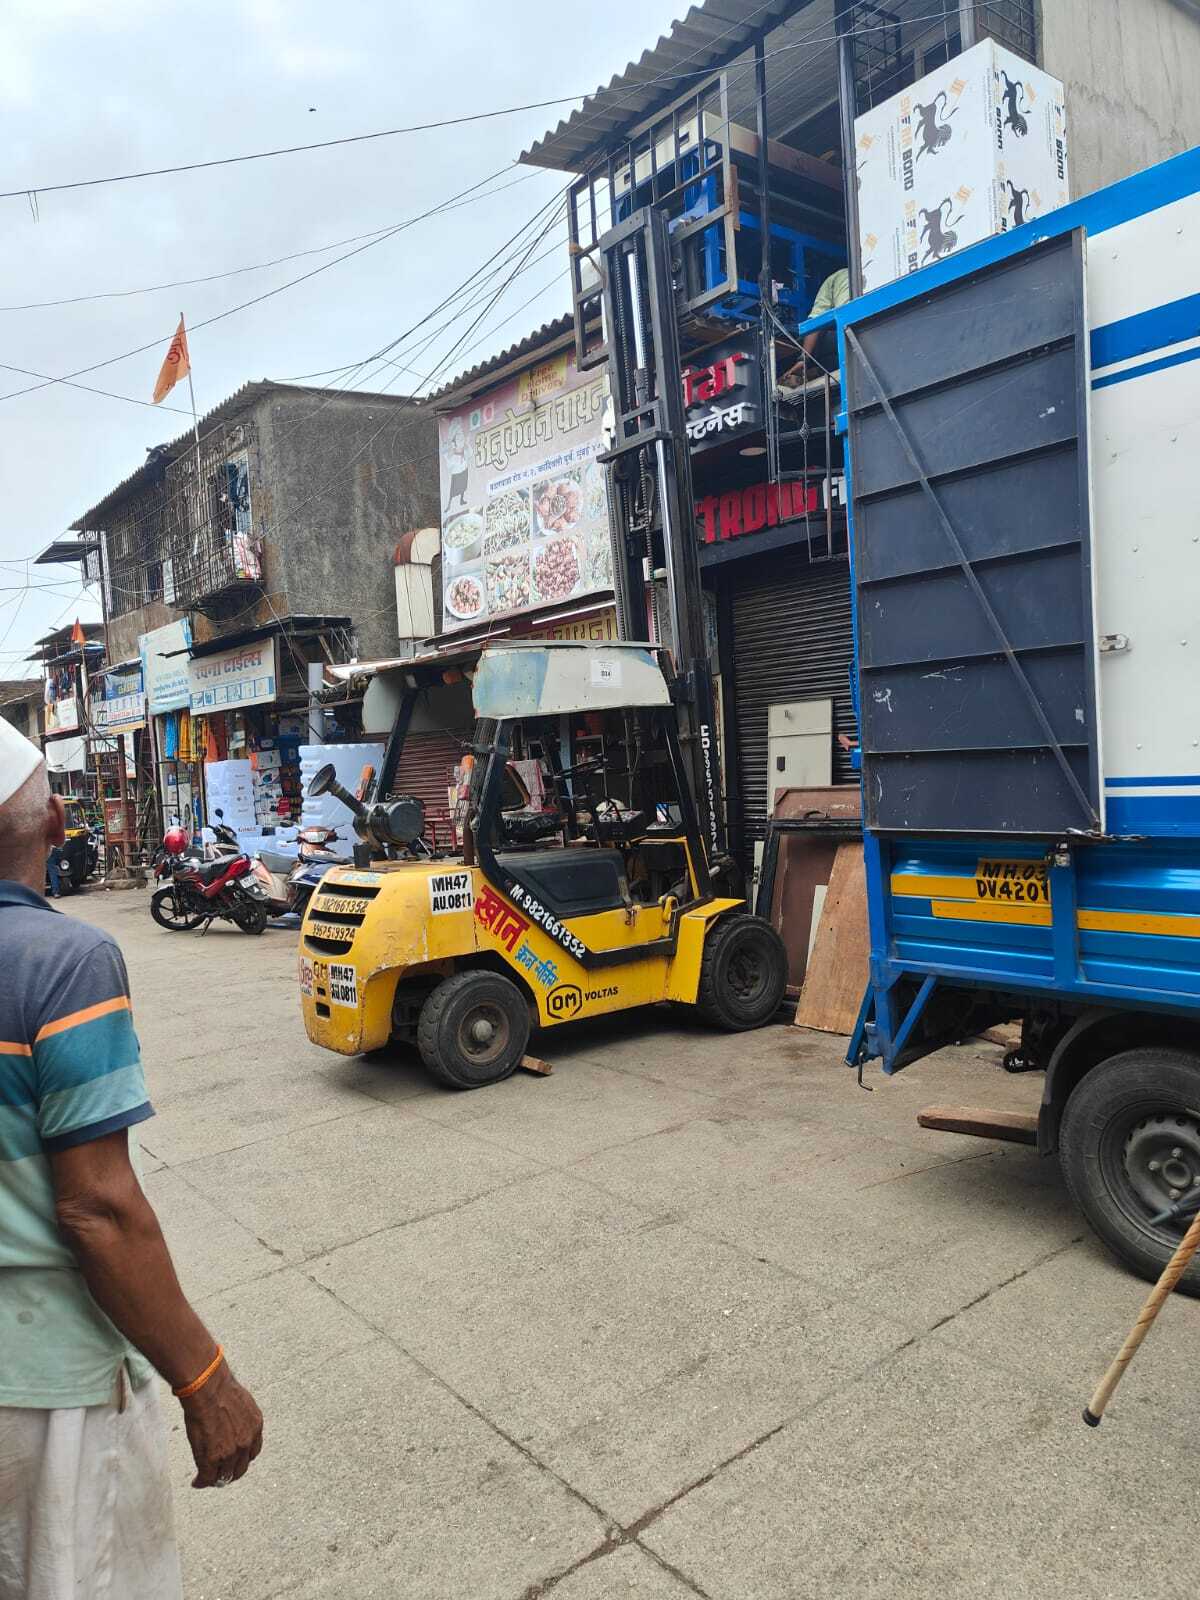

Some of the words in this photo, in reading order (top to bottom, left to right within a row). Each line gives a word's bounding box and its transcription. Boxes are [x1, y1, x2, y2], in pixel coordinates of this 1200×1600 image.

[902, 147, 916, 191] BOND
[694, 480, 818, 543] TRONG
[432, 893, 472, 912] AU.0811
[474, 884, 531, 953] खान
[552, 992, 578, 1012] OM
[584, 986, 619, 1001] VOLTAS
